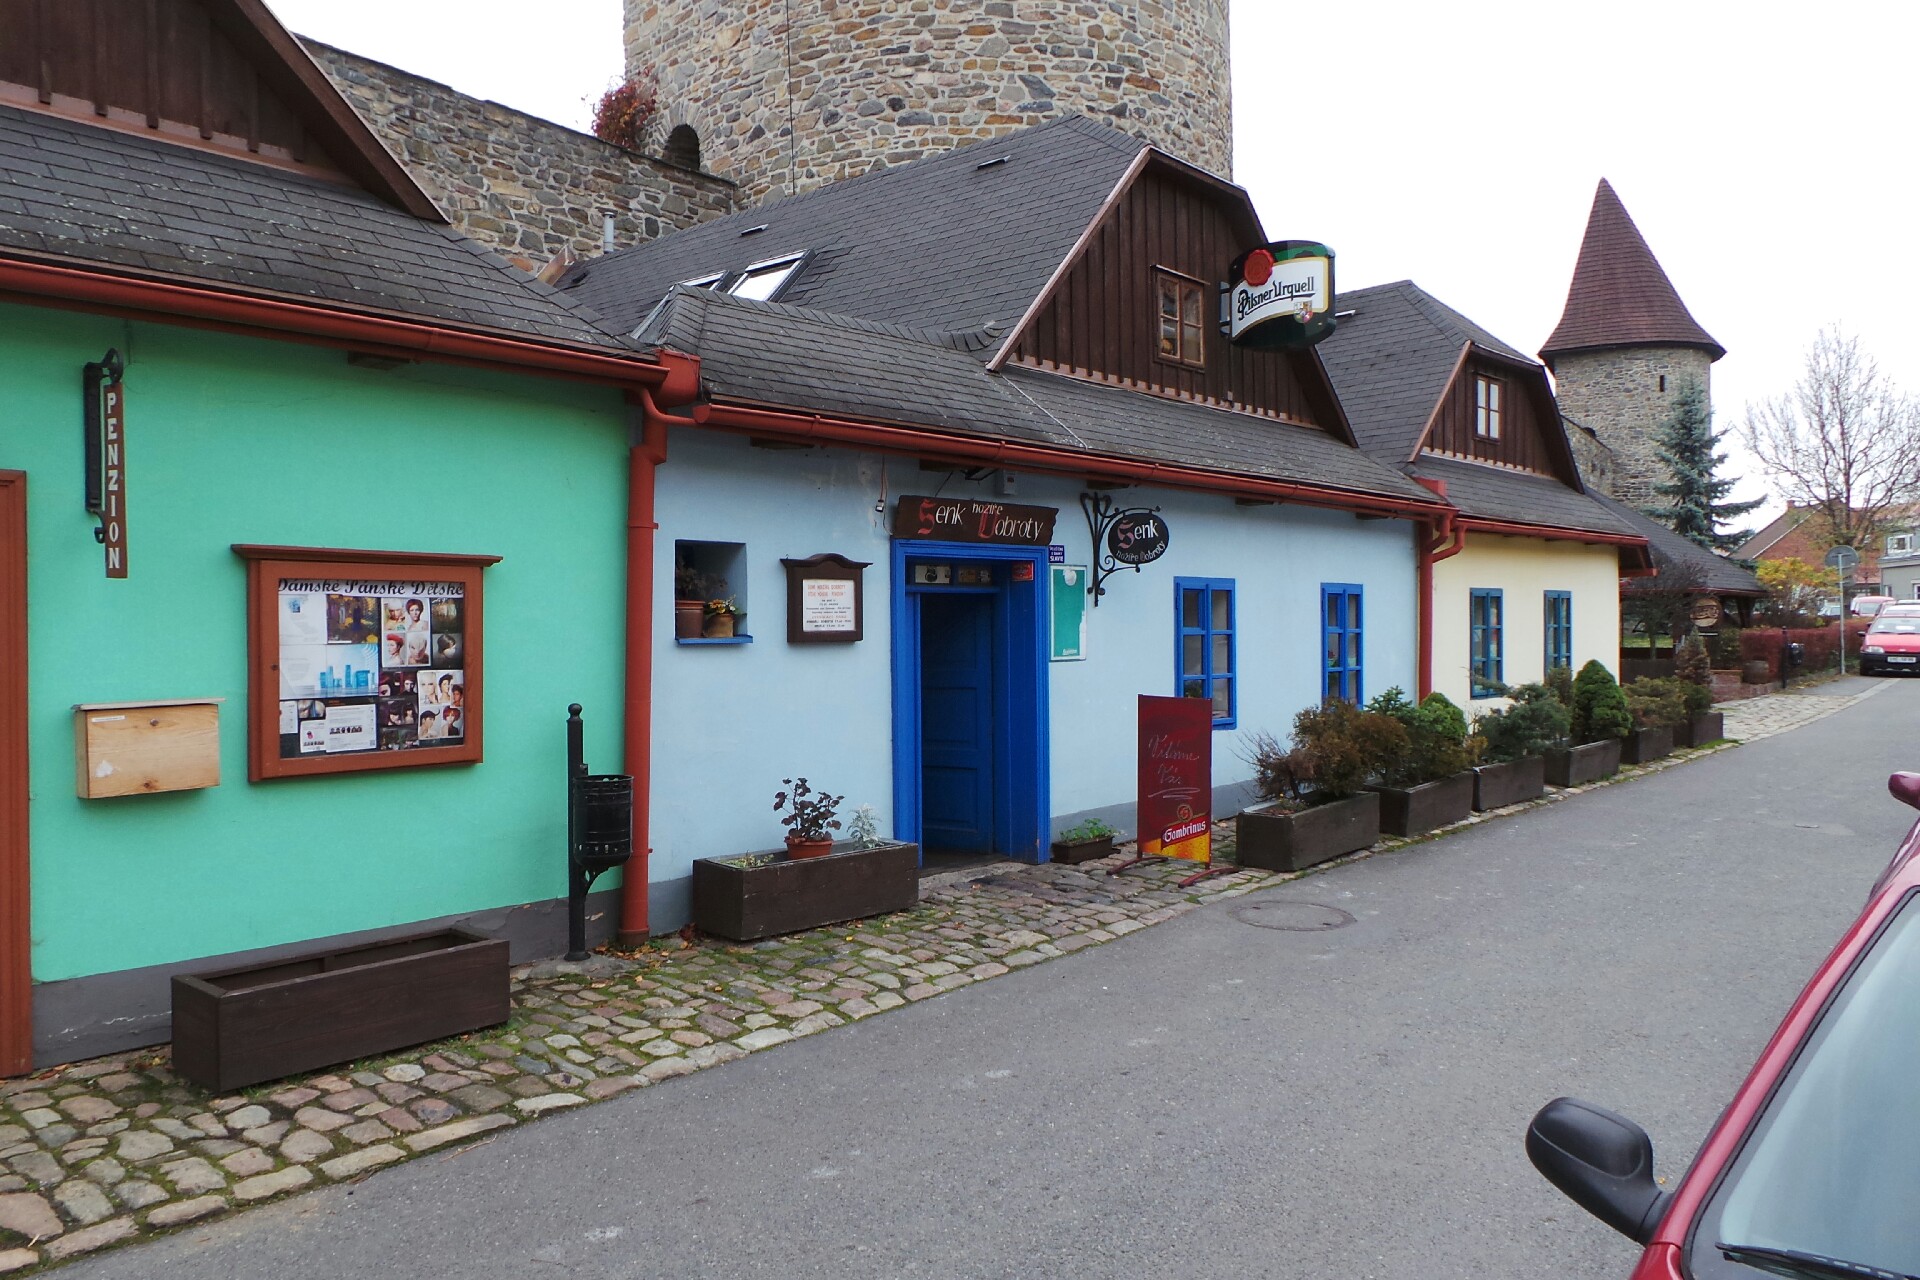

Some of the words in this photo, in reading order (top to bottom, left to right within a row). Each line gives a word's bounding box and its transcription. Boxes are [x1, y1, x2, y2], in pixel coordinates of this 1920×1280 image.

[1238, 288, 1274, 321] Pilsner
[1273, 276, 1314, 301] Urquell
[107, 392, 120, 569] PENZION
[978, 511, 1044, 541] Dobroty
[344, 580, 406, 595] Pánské
[1163, 820, 1206, 843] Gambrinus
